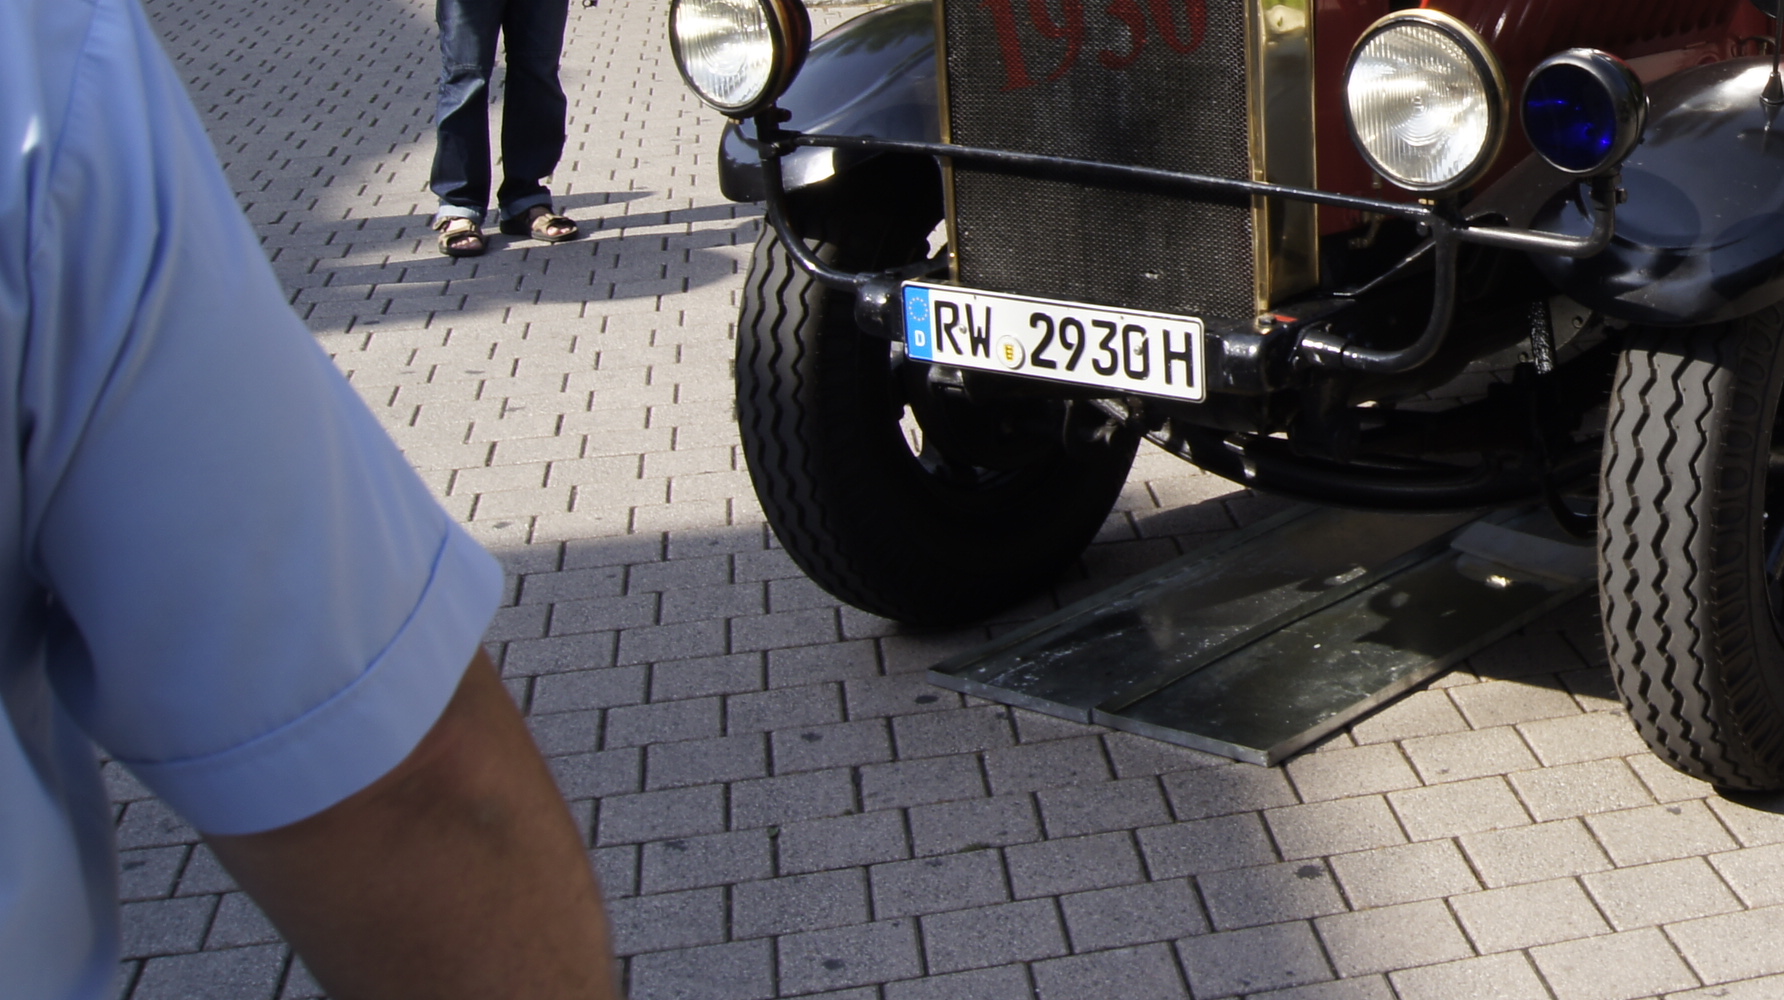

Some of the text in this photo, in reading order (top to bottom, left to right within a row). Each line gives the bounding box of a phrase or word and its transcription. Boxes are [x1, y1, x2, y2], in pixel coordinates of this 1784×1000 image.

[914, 330, 926, 347] D
[934, 300, 1194, 388] RW 2930 H
